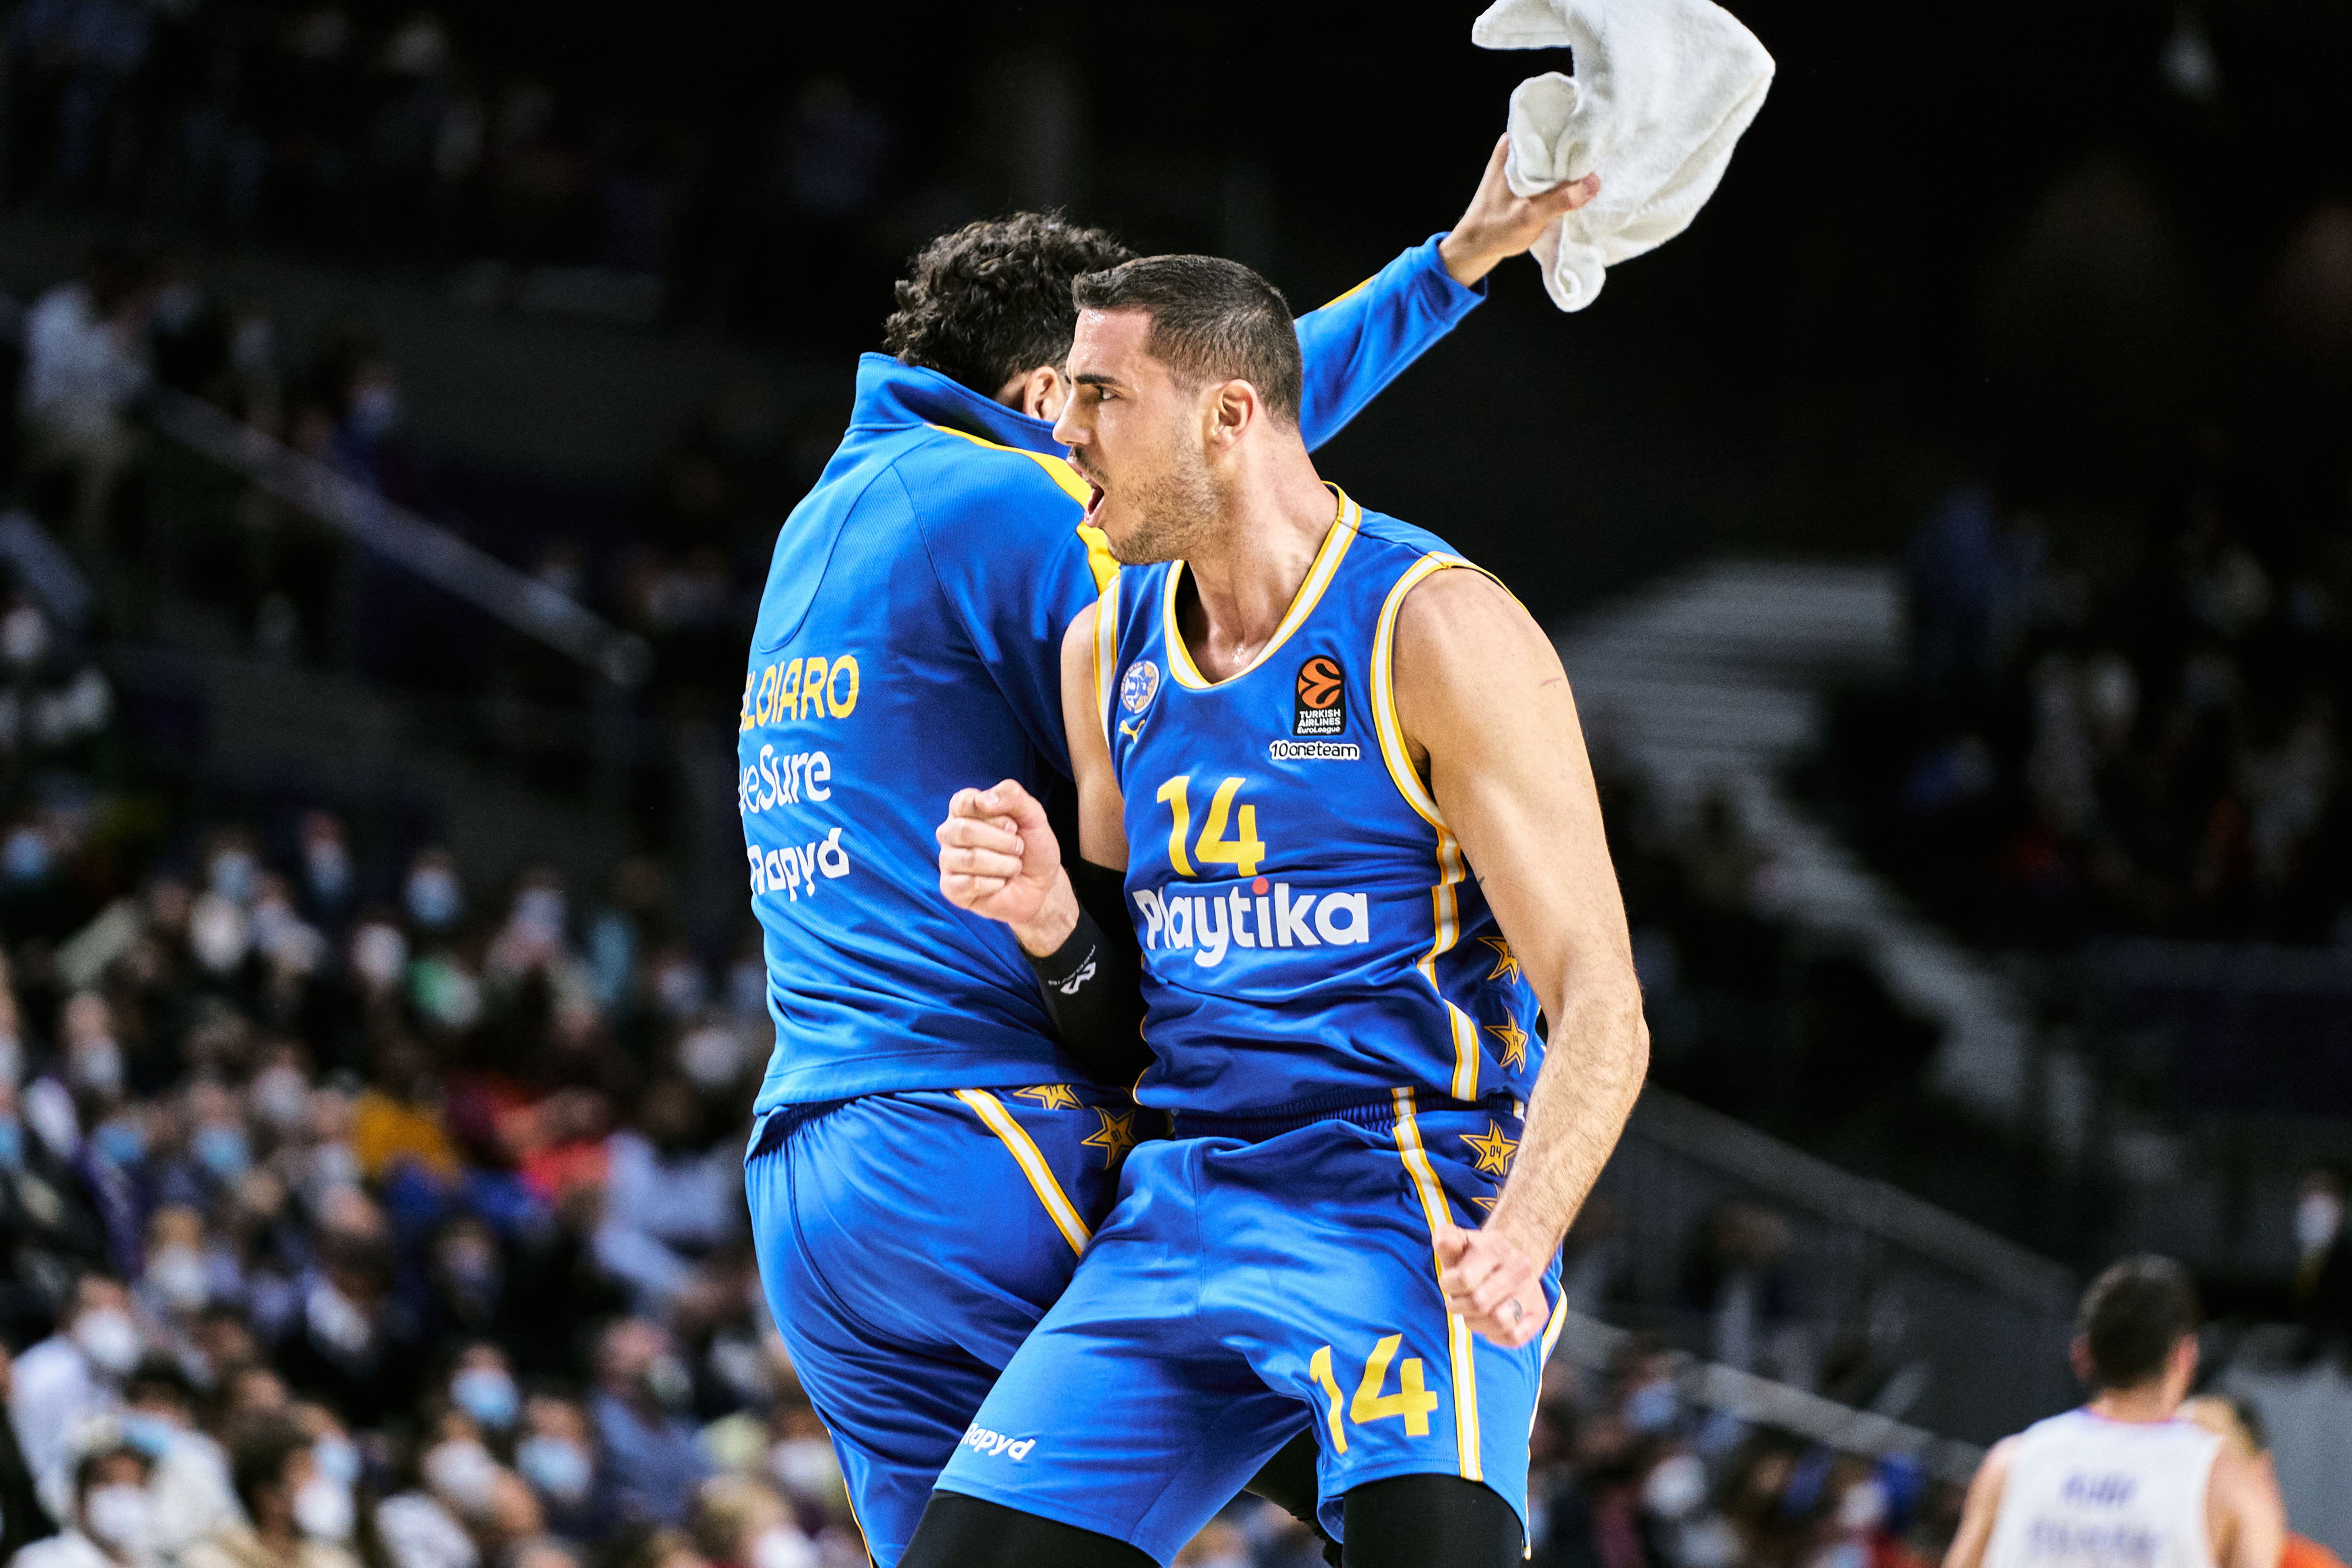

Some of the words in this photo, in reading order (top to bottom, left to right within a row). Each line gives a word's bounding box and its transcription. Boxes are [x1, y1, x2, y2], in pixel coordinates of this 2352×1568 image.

[1298, 717, 1341, 727] AIRLINES
[1299, 708, 1341, 718] TURKISH
[1157, 775, 1265, 877] 14
[1132, 877, 1369, 967] Playtika
[1512, 1035, 1519, 1047] 14
[1490, 1145, 1501, 1158] 04
[1309, 1333, 1438, 1455] 14
[960, 1423, 1036, 1460] Rapyd
